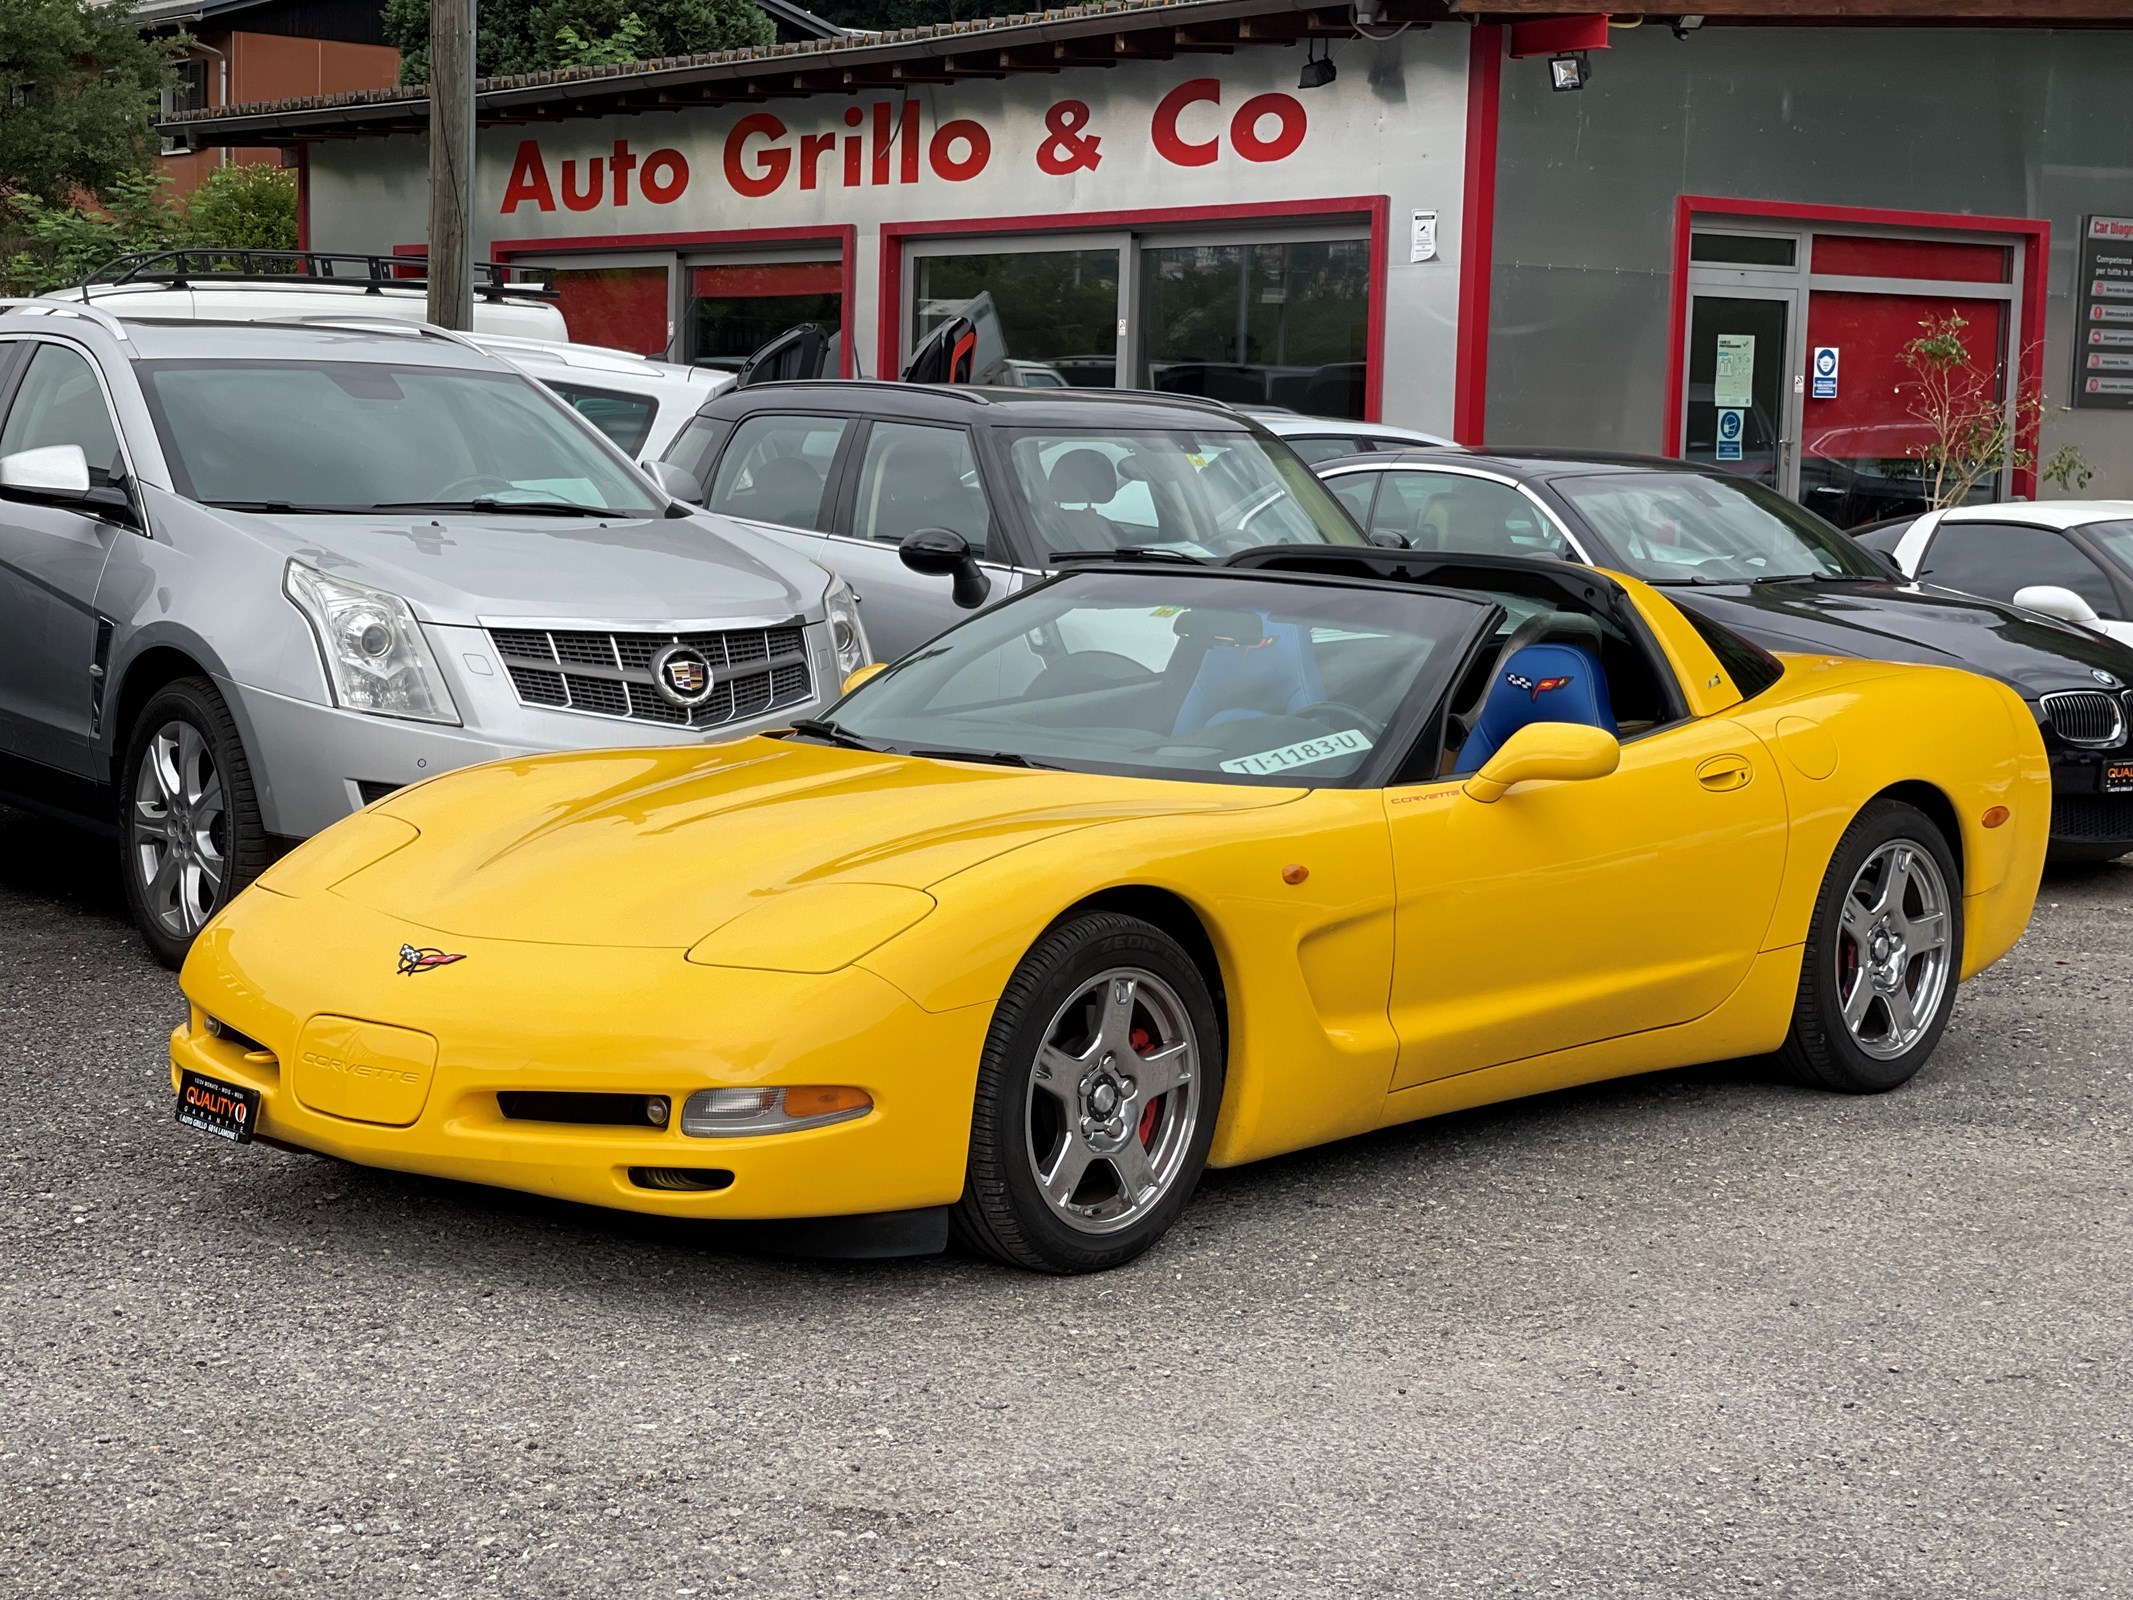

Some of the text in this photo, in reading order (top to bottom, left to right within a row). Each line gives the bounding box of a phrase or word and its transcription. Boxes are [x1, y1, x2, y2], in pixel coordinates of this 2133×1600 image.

[500, 78, 1308, 214] Auto Grillo & Co
[2094, 221, 2108, 233] Car
[1391, 790, 1460, 804] CORVETTE
[1099, 934, 1158, 955] ZEON
[301, 1051, 420, 1085] CORVETTE
[182, 1115, 193, 1125] AUTO
[193, 1118, 208, 1130] GRILLO
[183, 1105, 244, 1134] GARANTIE
